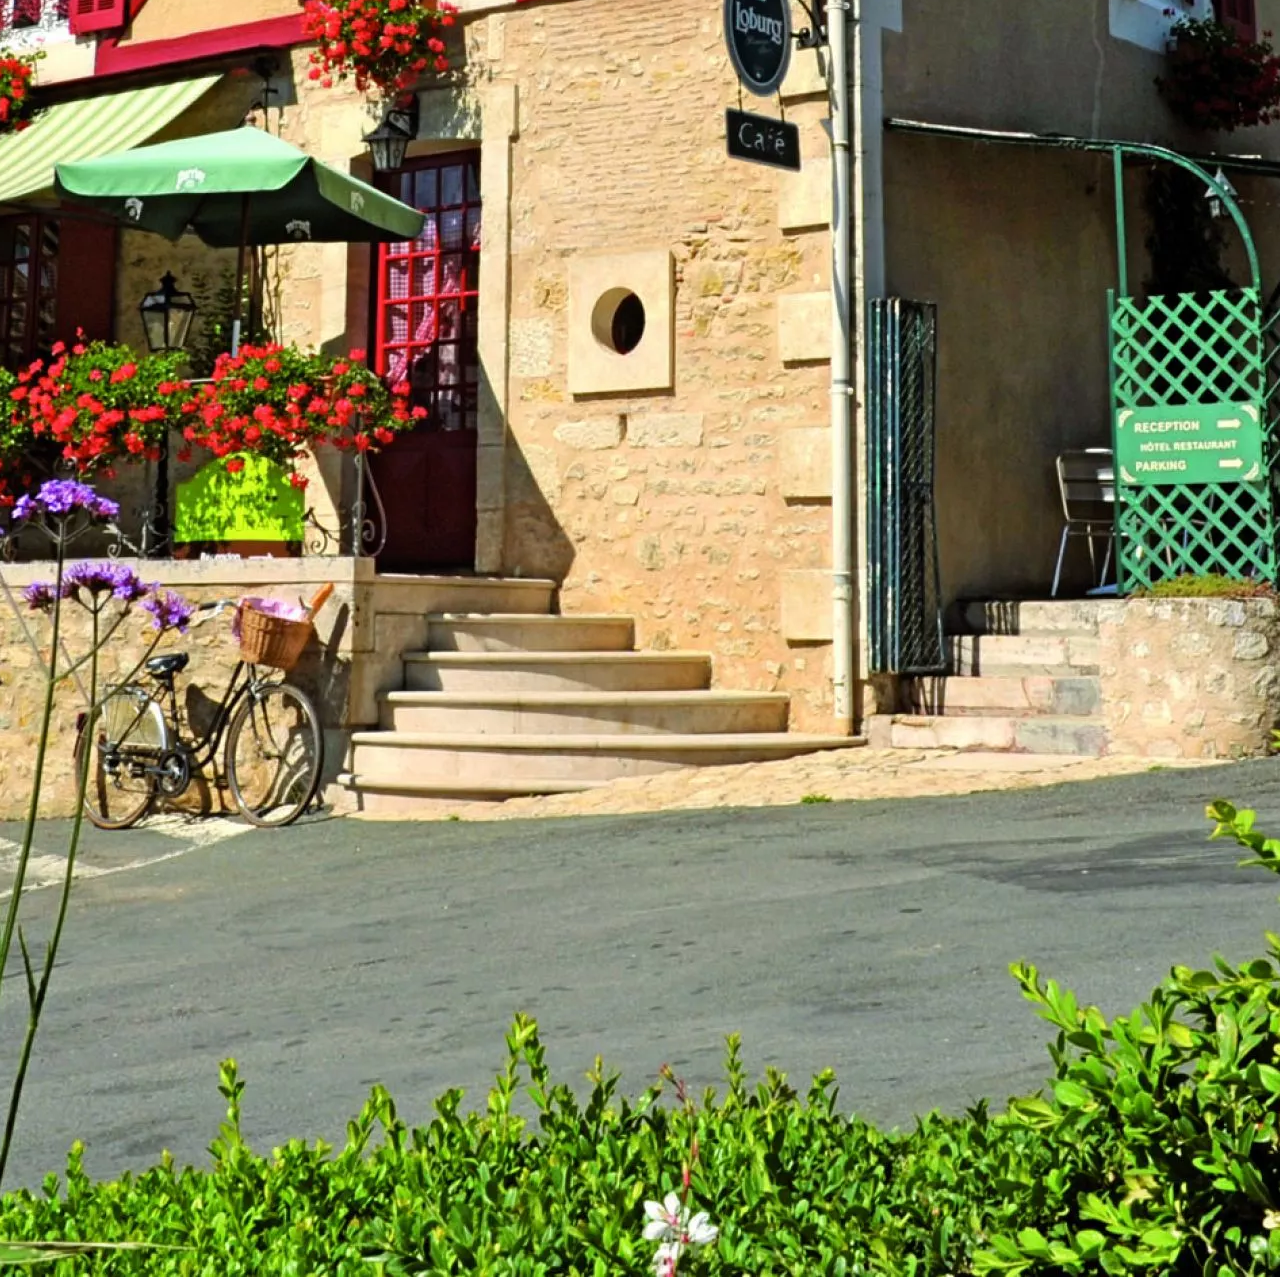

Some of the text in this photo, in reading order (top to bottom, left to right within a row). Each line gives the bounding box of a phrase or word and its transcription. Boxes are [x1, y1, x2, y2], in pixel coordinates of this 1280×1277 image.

[735, 2, 783, 45] Loburg
[1134, 420, 1200, 433] RECEPTION
[1173, 439, 1238, 451] RESTAURANT
[1135, 460, 1187, 472] PARKING
